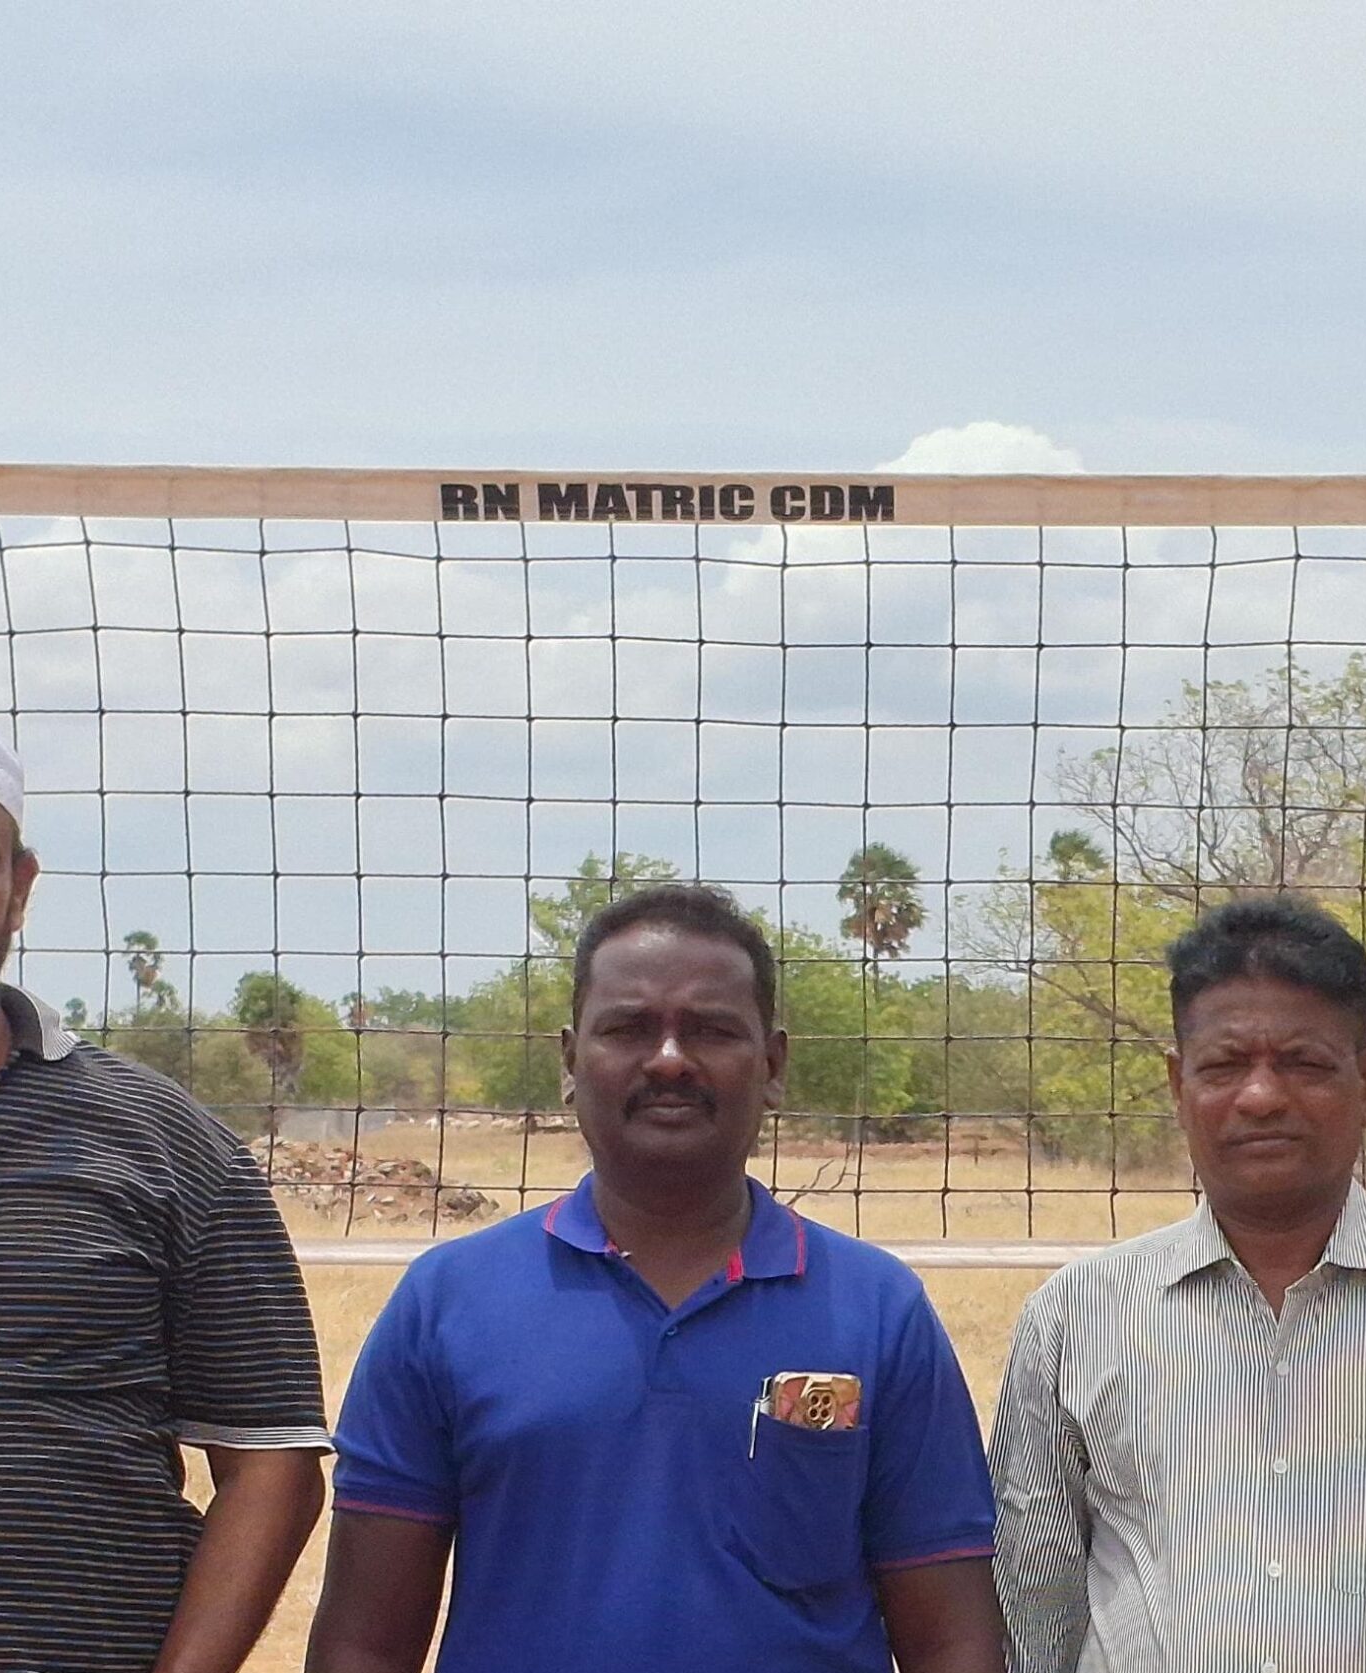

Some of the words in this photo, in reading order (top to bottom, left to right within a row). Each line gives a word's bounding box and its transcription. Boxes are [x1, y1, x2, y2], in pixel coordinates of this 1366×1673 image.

[440, 483, 521, 520] RN
[537, 483, 755, 521] MATRIC
[770, 484, 895, 522] CDM
